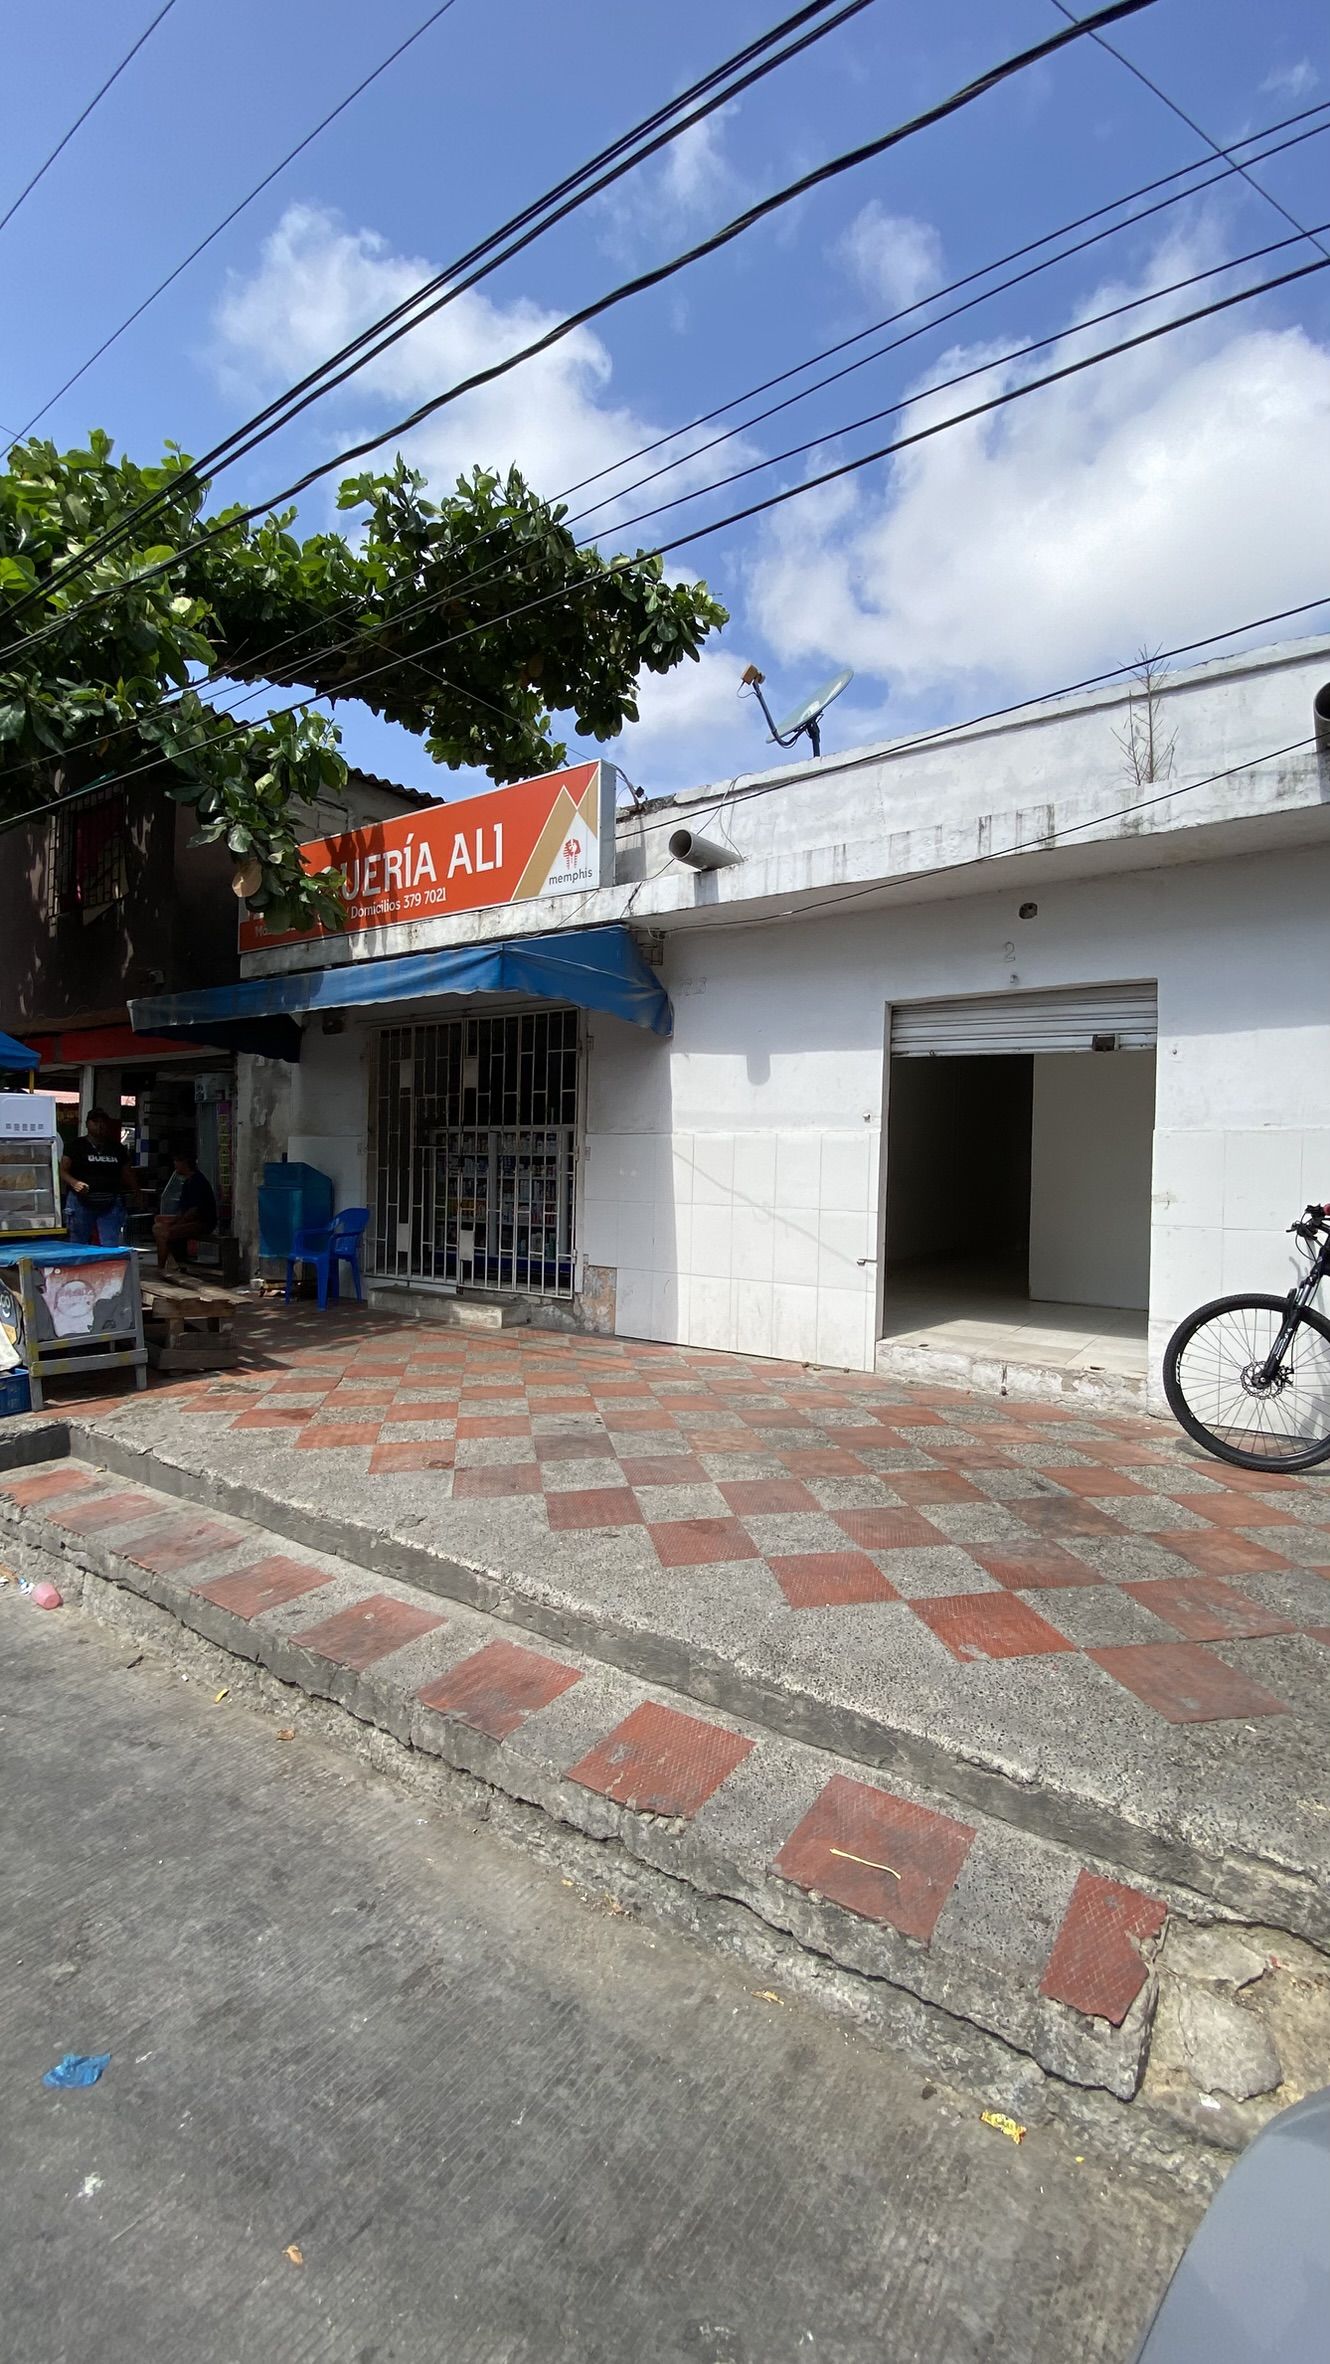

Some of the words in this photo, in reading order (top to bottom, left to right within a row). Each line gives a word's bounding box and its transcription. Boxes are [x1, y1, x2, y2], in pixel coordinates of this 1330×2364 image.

[447, 822, 503, 879] ALI
[548, 867, 593, 885] memphis
[350, 897, 401, 920] Domicilios
[403, 892, 422, 910] 379
[424, 887, 446, 905] 7021
